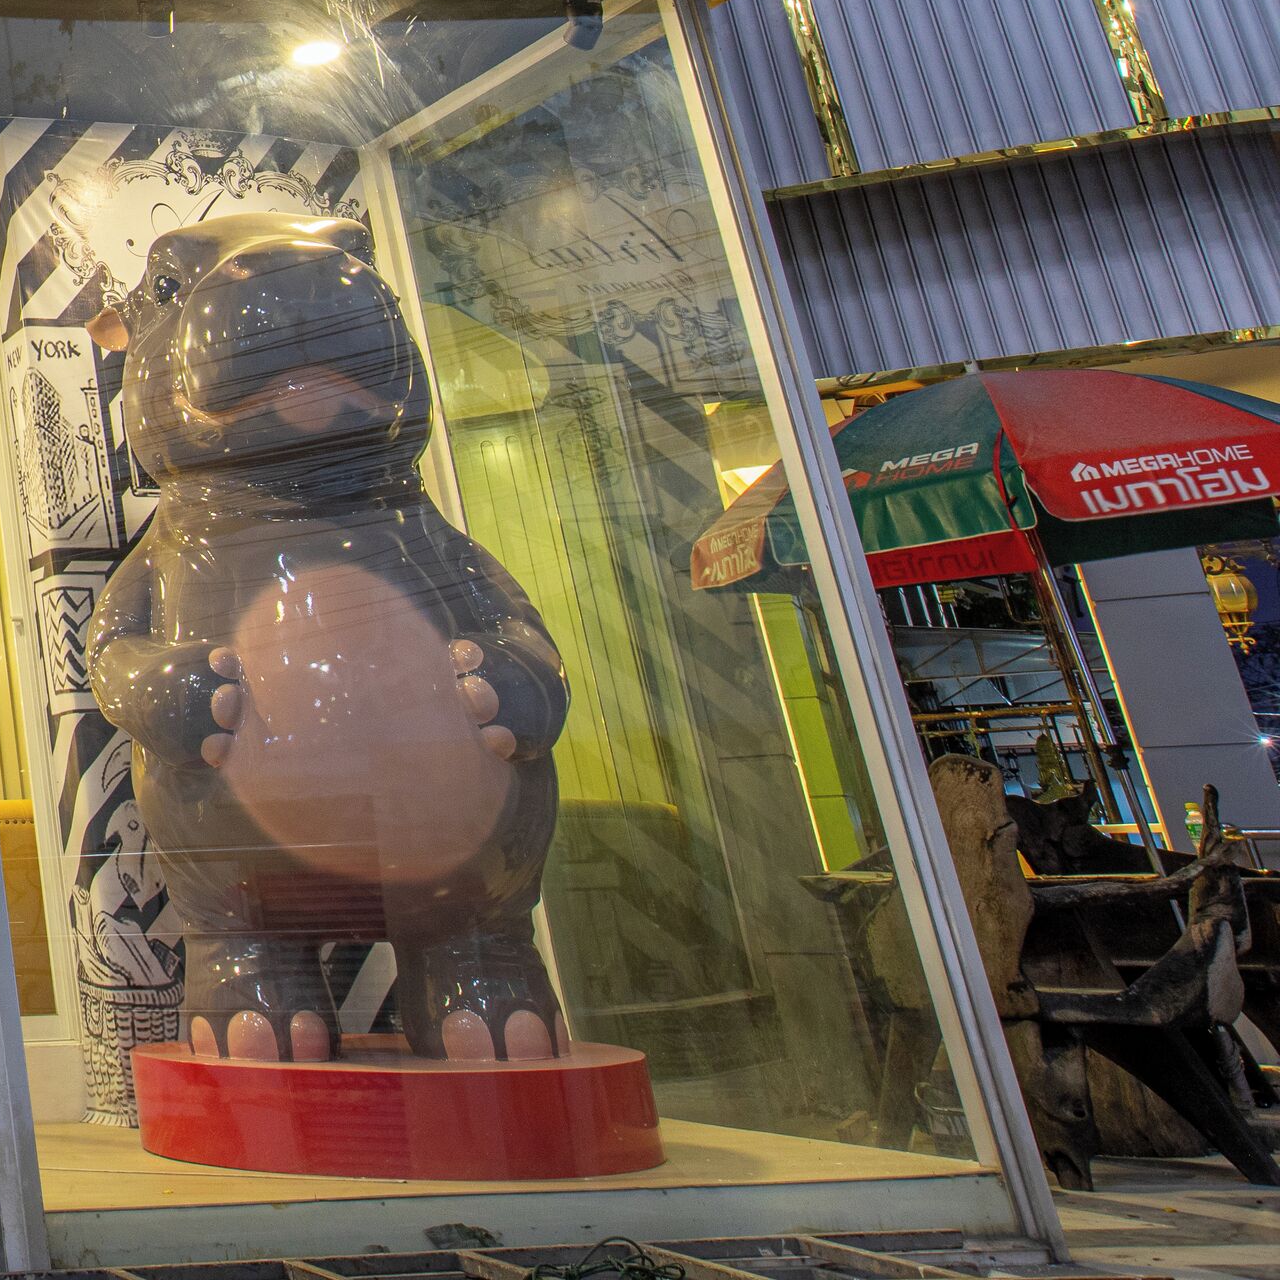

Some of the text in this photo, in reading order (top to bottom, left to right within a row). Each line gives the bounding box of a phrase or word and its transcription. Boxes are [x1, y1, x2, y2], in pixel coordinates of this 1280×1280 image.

[6, 339, 82, 372] NEW YORK
[873, 456, 977, 486] HOME
[879, 442, 980, 473] MEGA
[1100, 444, 1254, 478] MEGAHOME
[1080, 466, 1271, 514] เมกาโฮม
